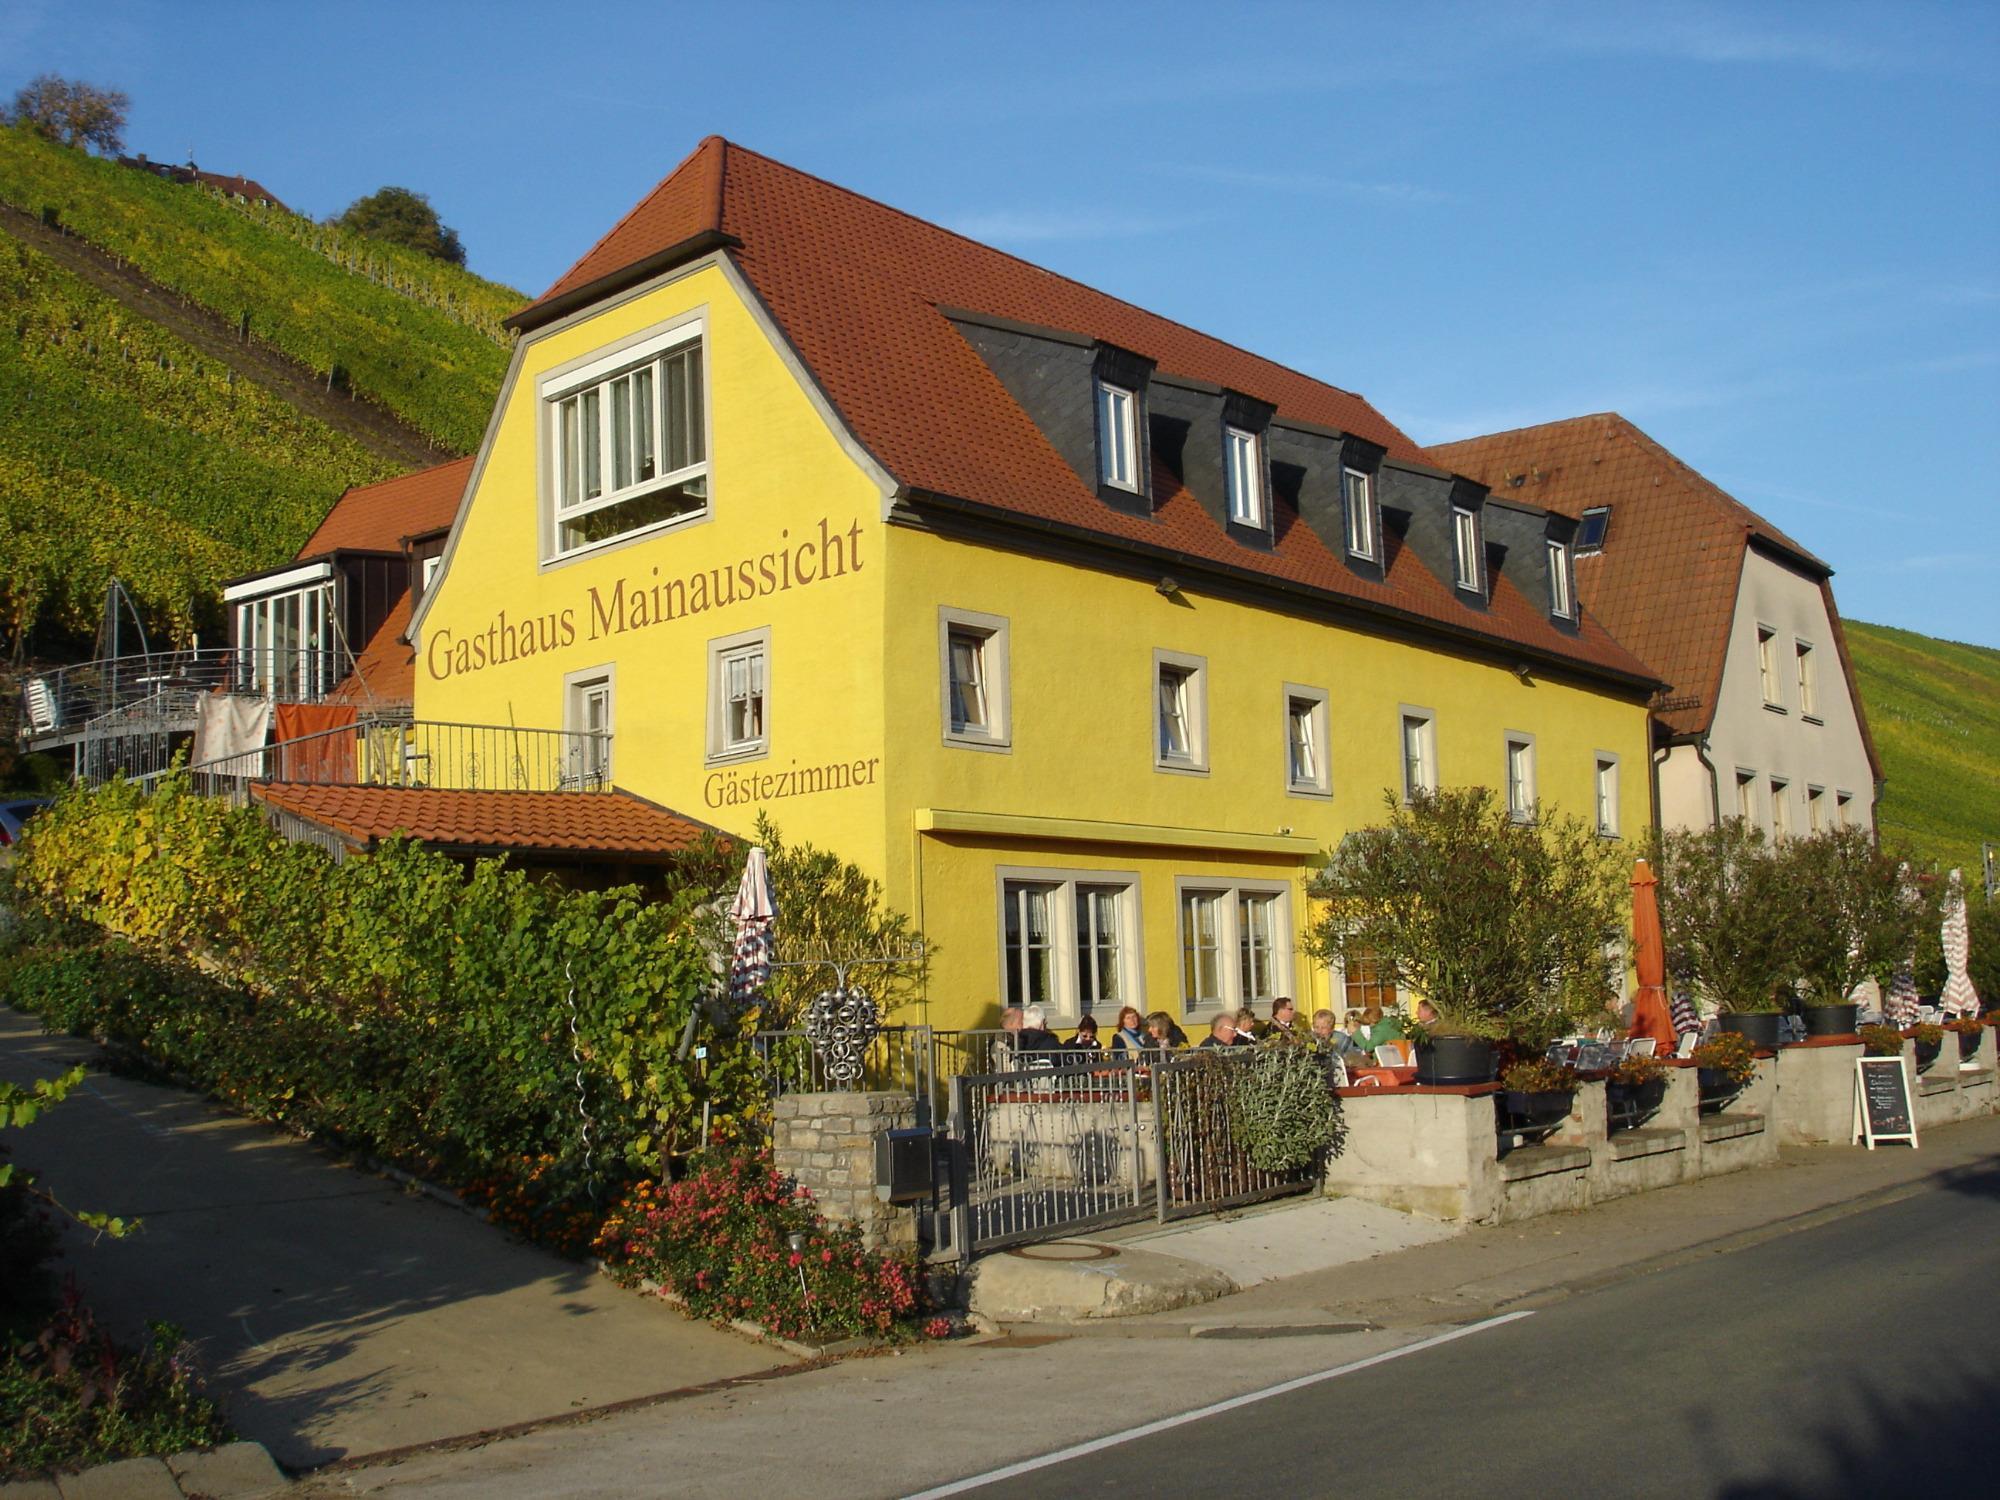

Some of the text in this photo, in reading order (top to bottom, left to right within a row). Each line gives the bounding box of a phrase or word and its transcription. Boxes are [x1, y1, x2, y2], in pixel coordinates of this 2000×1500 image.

[428, 517, 865, 681] Gasthaus Mainaussicht
[704, 757, 880, 809] Gästezimmer
